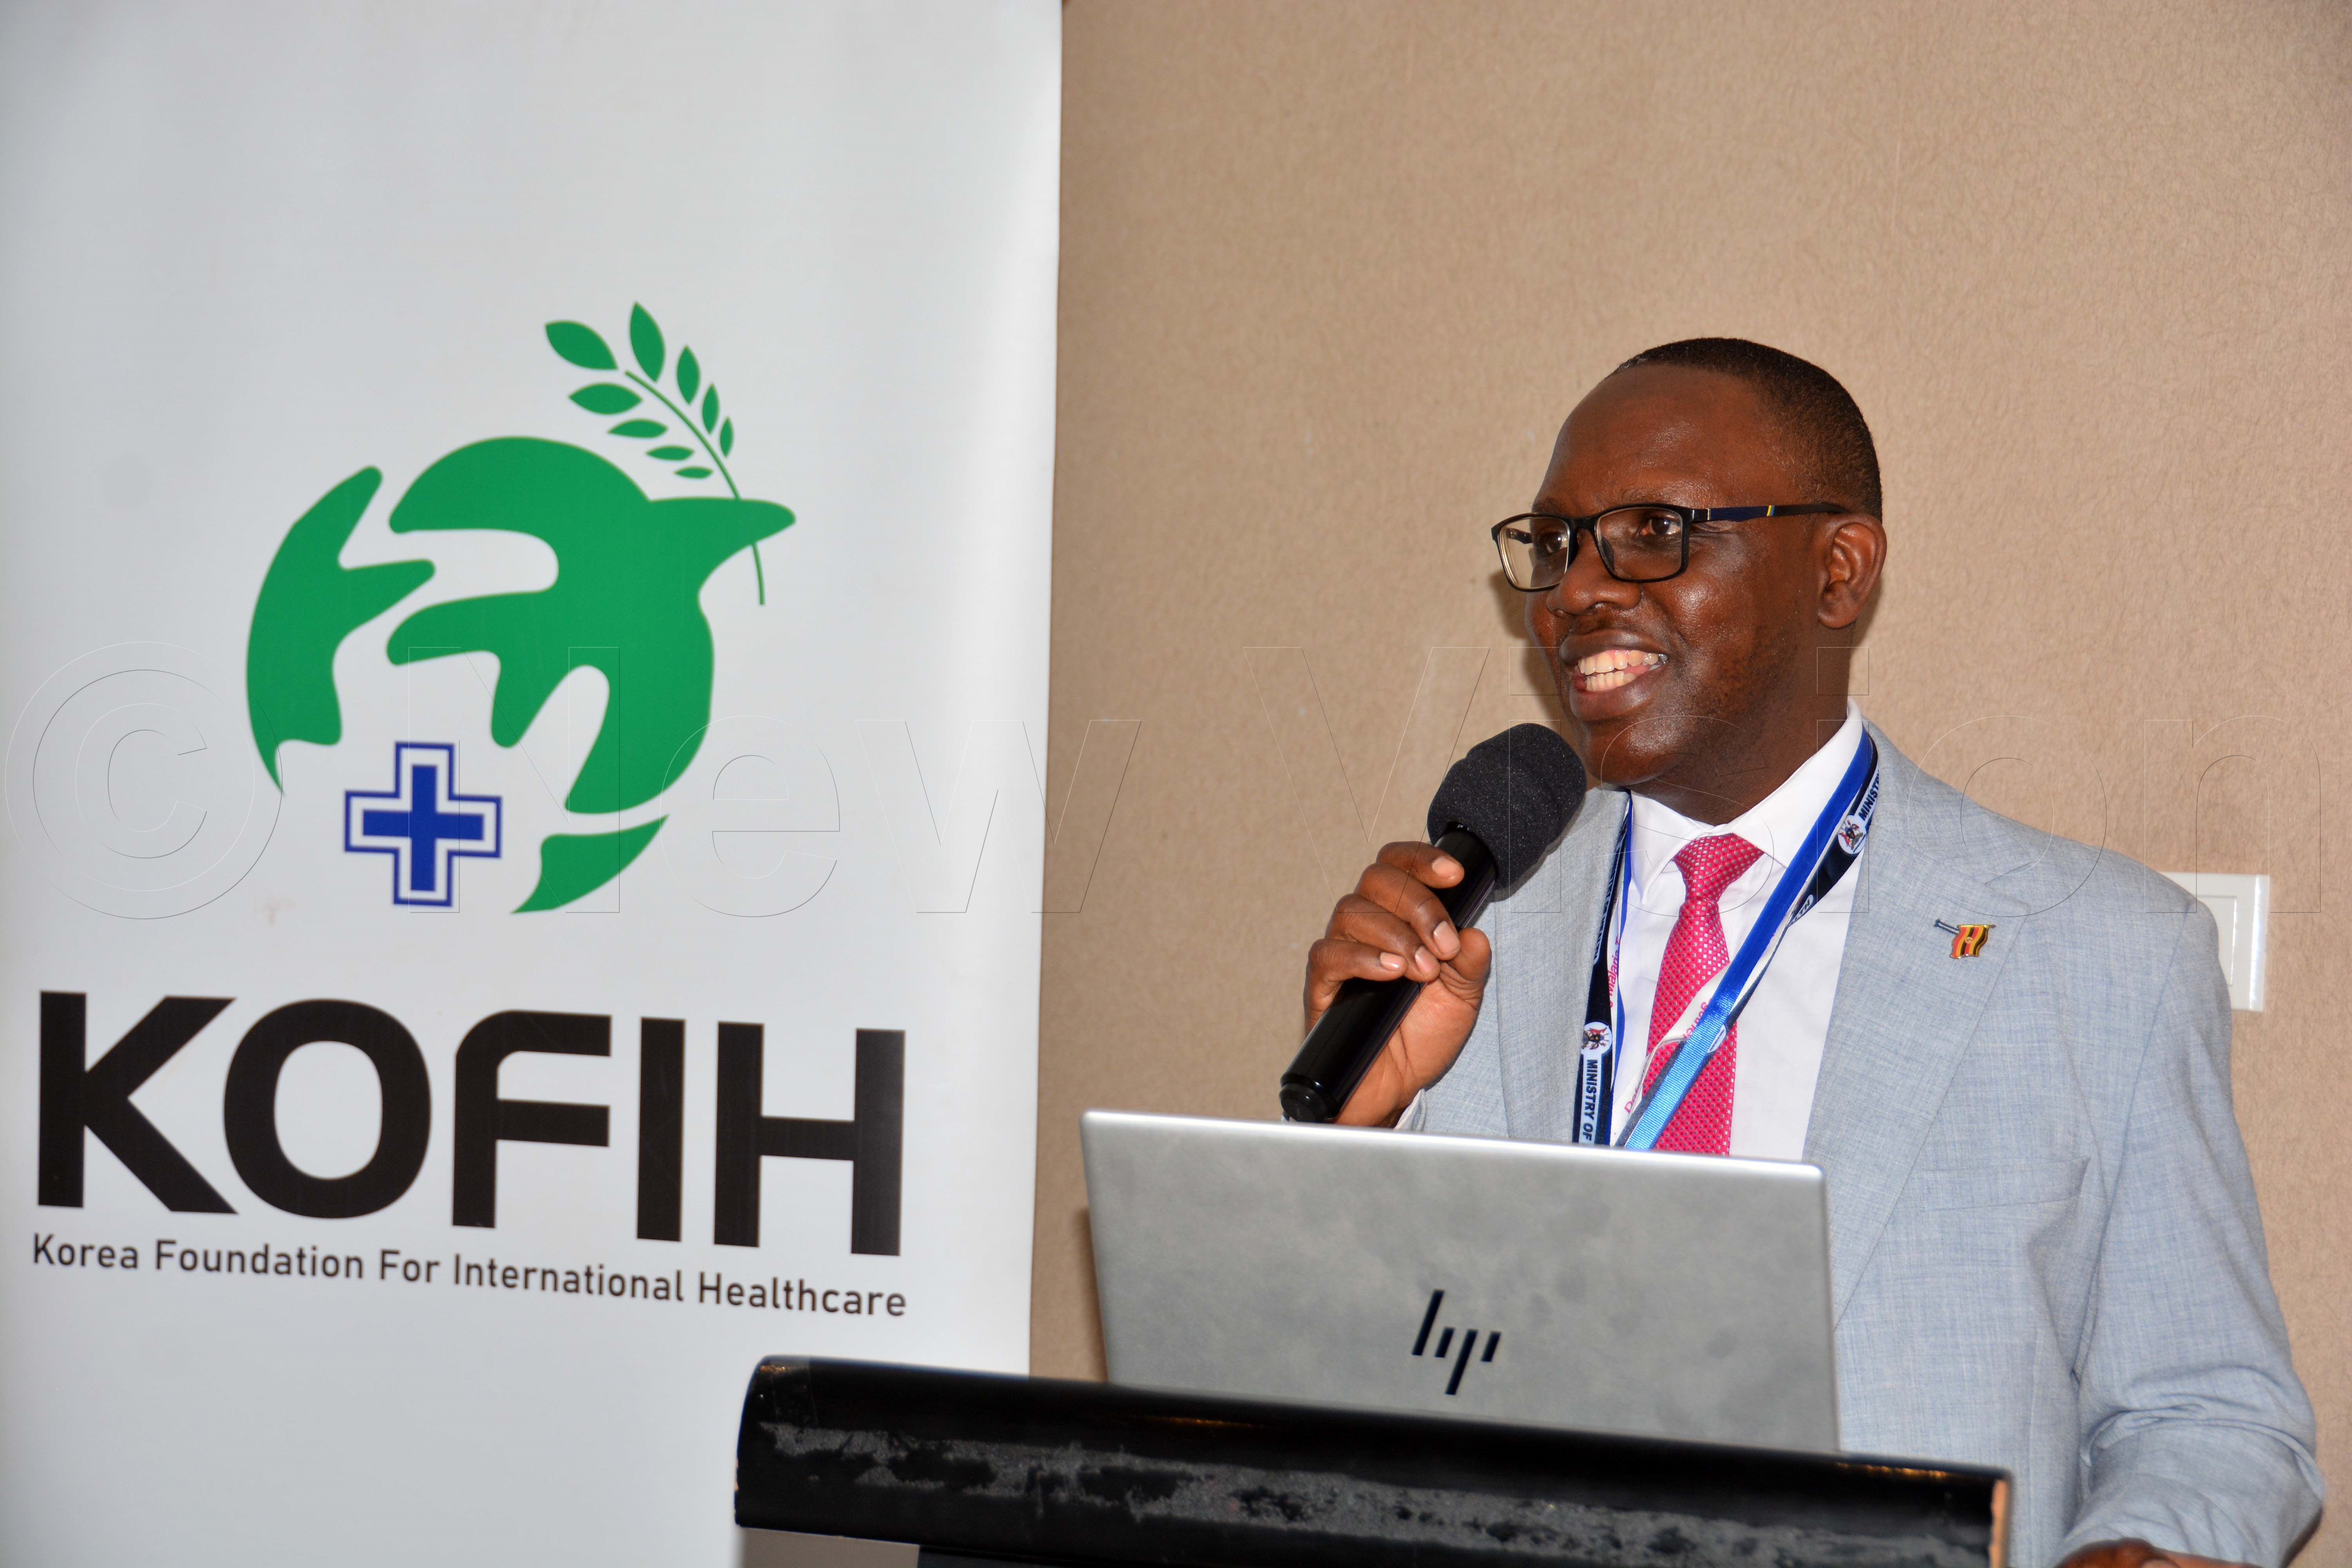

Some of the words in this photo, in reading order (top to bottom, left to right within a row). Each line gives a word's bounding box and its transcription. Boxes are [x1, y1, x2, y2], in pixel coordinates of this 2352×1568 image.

[1858, 769, 1879, 821] MINISTR
[37, 990, 905, 1256] KOFIH
[1584, 1059, 1598, 1121] MINISTRY
[1583, 1122, 1593, 1142] OF
[33, 1233, 138, 1269] Korea
[156, 1240, 363, 1279] Foundation
[380, 1249, 440, 1283] For
[455, 1254, 683, 1301] International
[699, 1272, 905, 1317] Healthcare
[1411, 1289, 1502, 1396] hp
